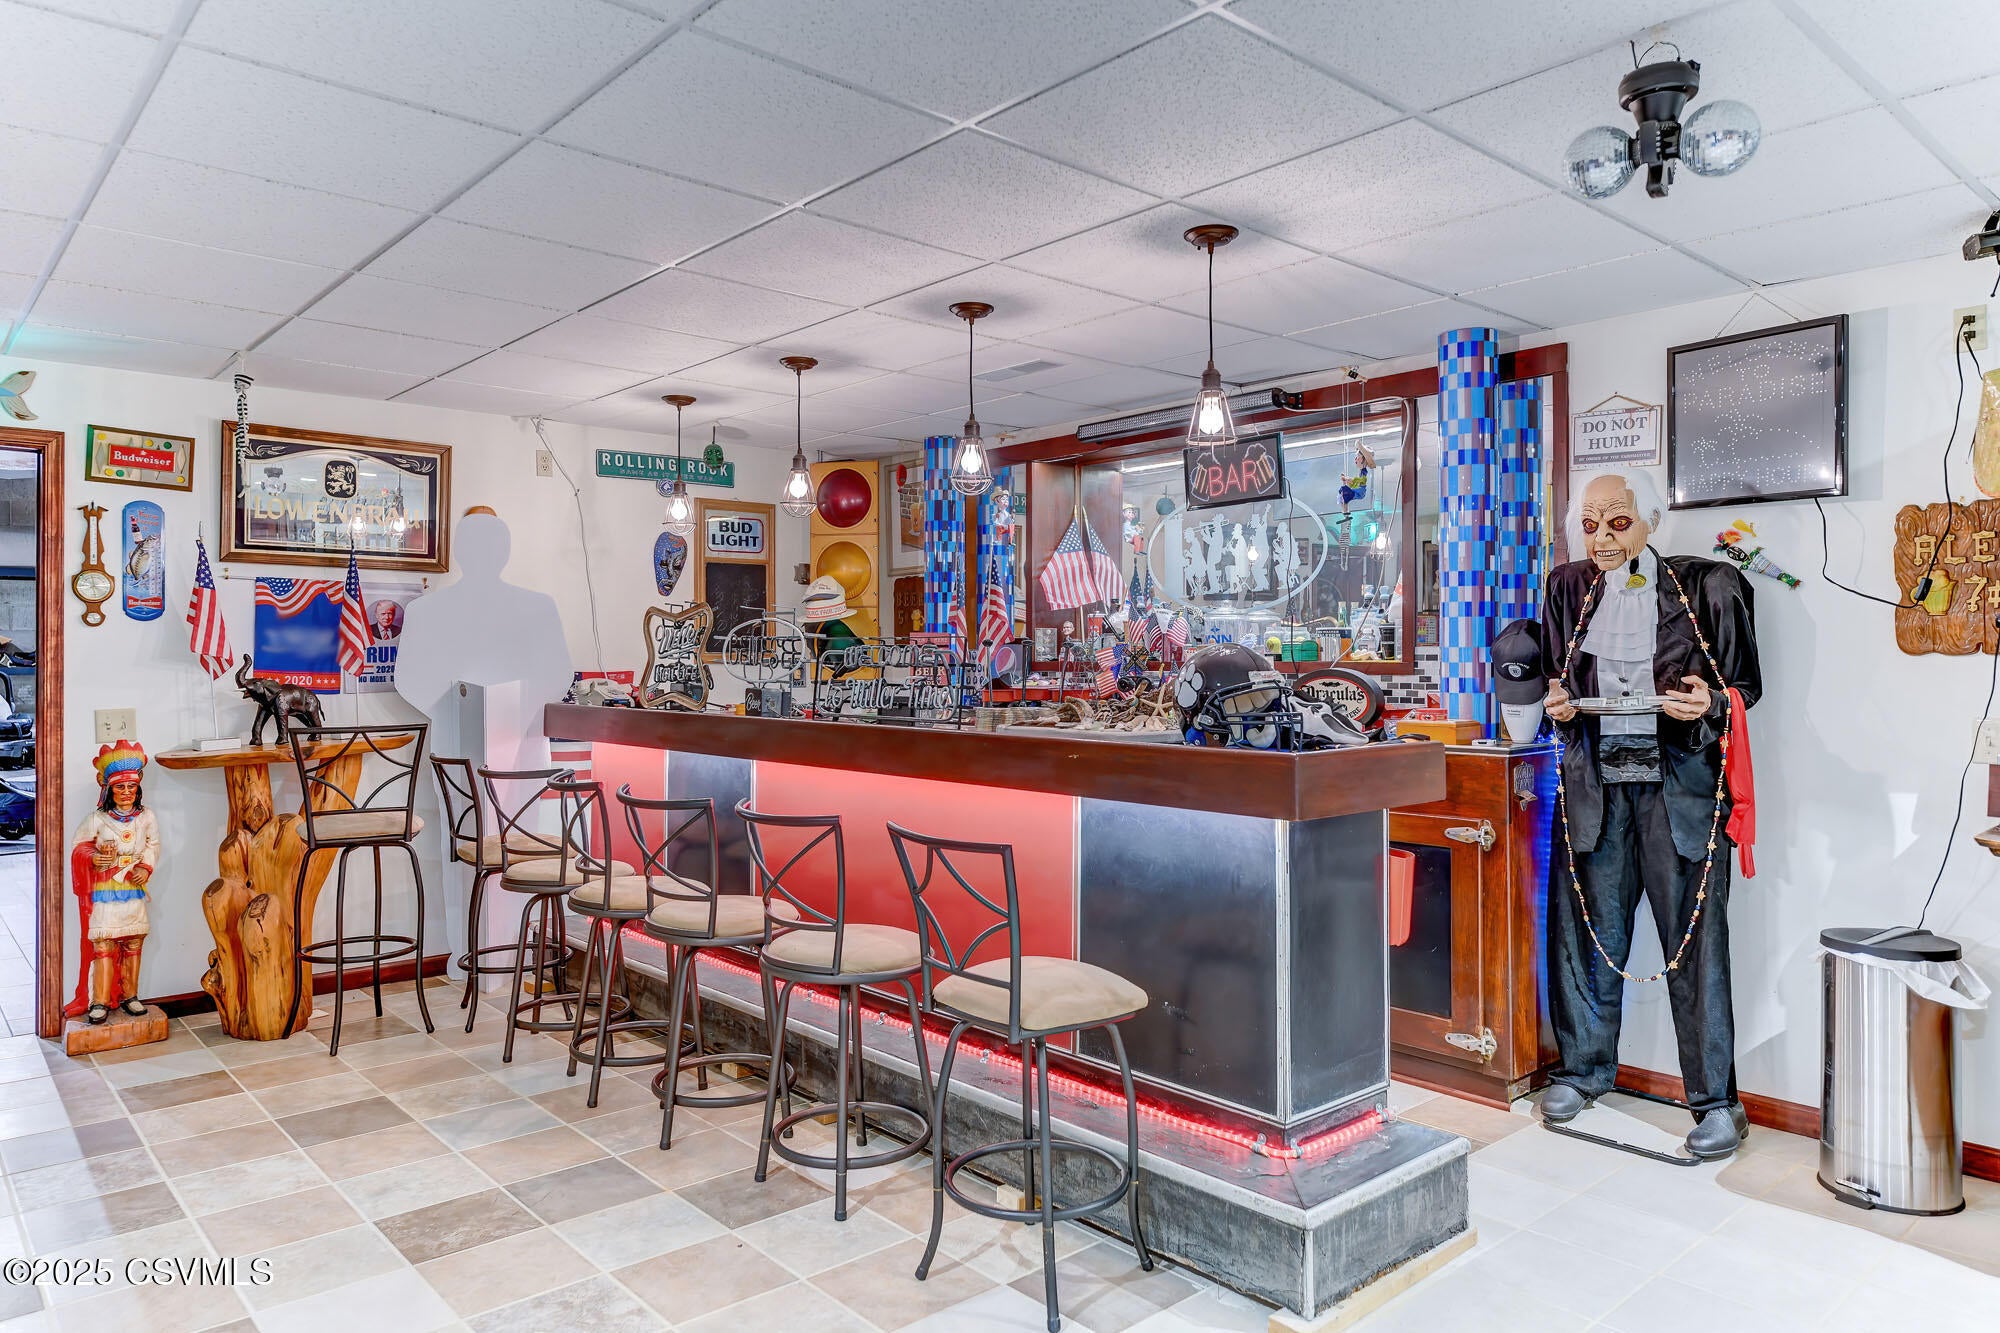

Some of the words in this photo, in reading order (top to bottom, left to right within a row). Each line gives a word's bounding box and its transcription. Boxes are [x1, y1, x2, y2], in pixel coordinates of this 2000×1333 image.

[1683, 371, 1828, 414] PARADISE
[1582, 420, 1607, 434] DO
[1611, 416, 1648, 431] NOT
[1588, 434, 1641, 450] HUMP
[113, 450, 172, 467] Budweiser
[602, 452, 677, 472] ROLLING
[1208, 460, 1261, 497] BAR
[719, 520, 753, 534] BUD
[711, 534, 760, 548] LIGHT
[1913, 530, 1996, 566] ALE
[376, 665, 395, 674] 2020
[284, 675, 313, 686] 2020
[370, 675, 387, 683] MORE
